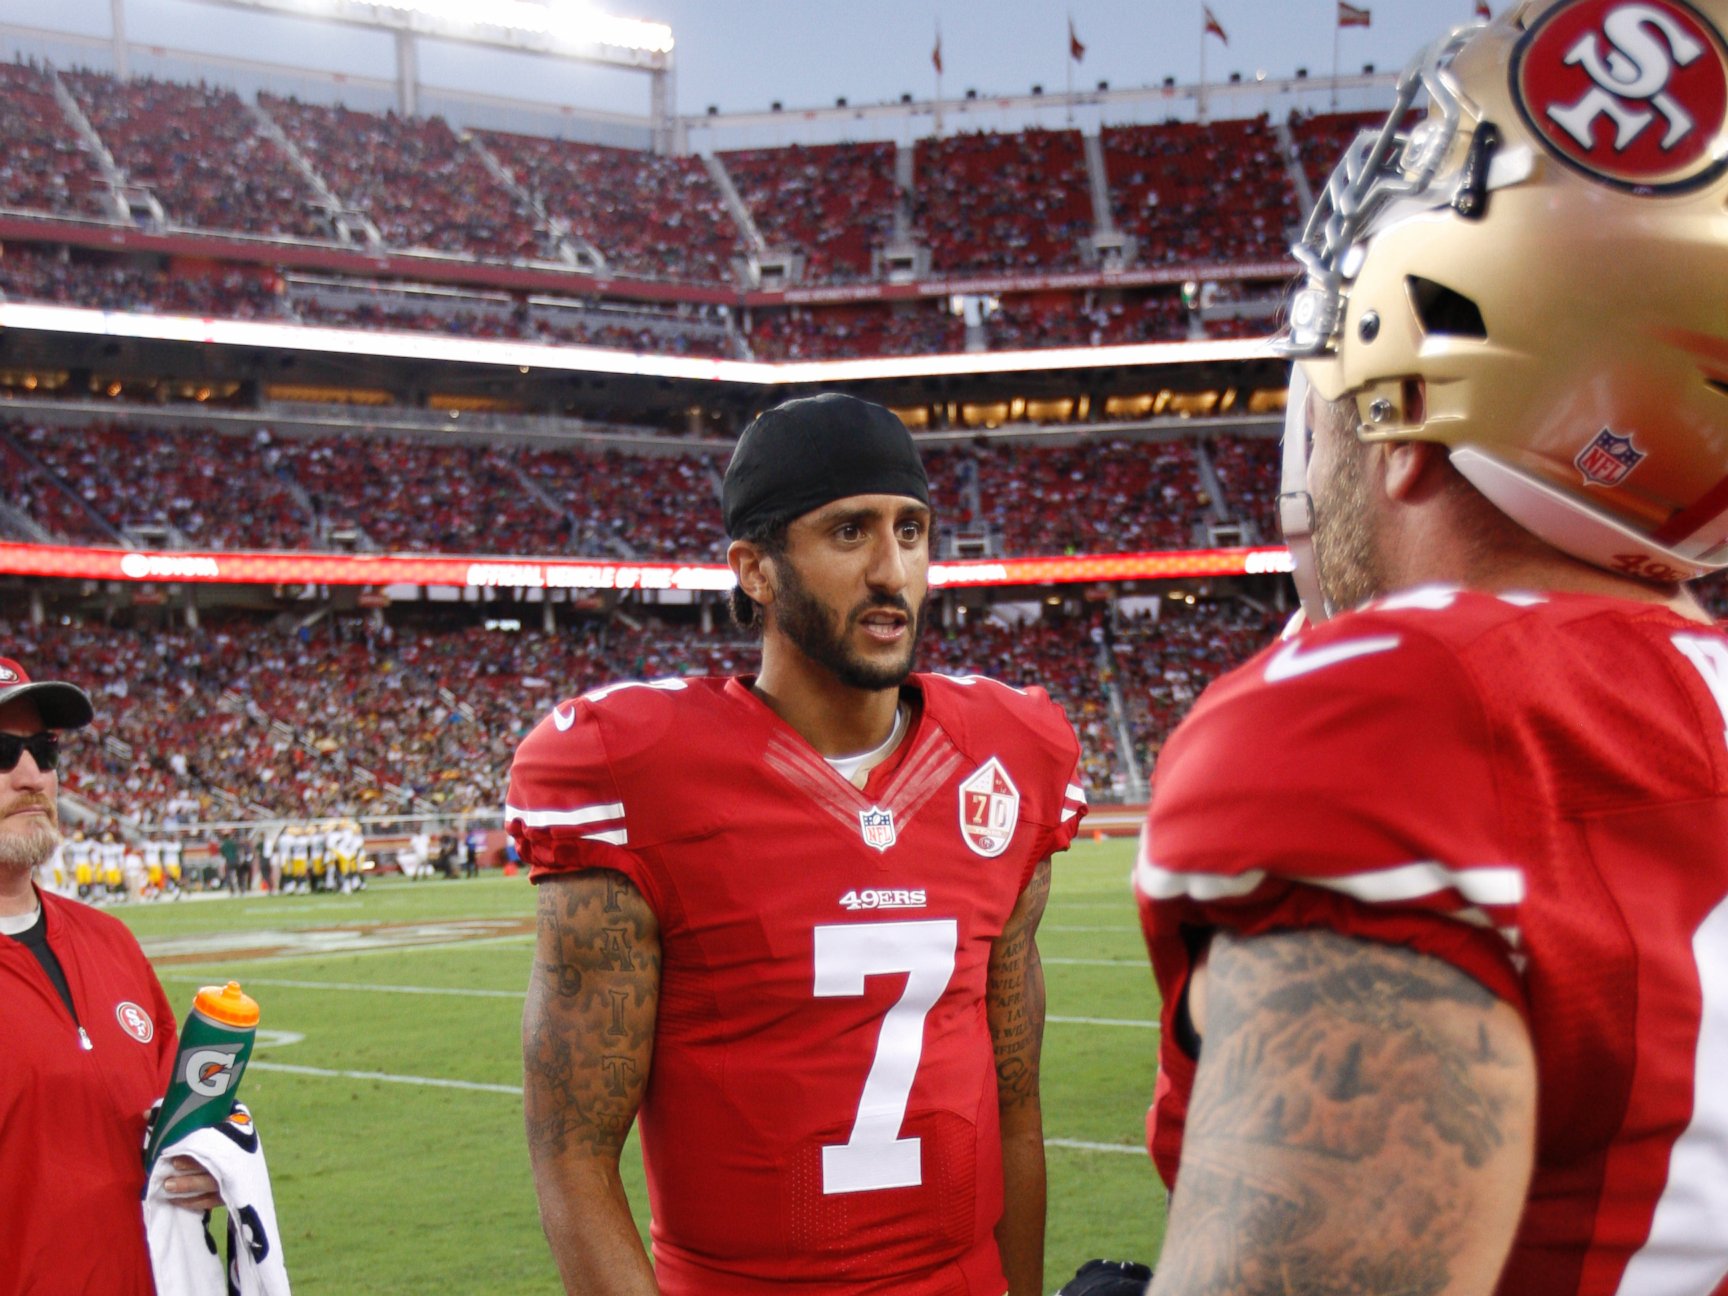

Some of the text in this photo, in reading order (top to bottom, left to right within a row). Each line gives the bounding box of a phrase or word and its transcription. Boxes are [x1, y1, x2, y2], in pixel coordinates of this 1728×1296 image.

[1582, 446, 1627, 482] NFL
[867, 826, 891, 842] NFL
[839, 889, 927, 910] 49ERS
[186, 1050, 236, 1097] G
[813, 919, 957, 1195] 7
